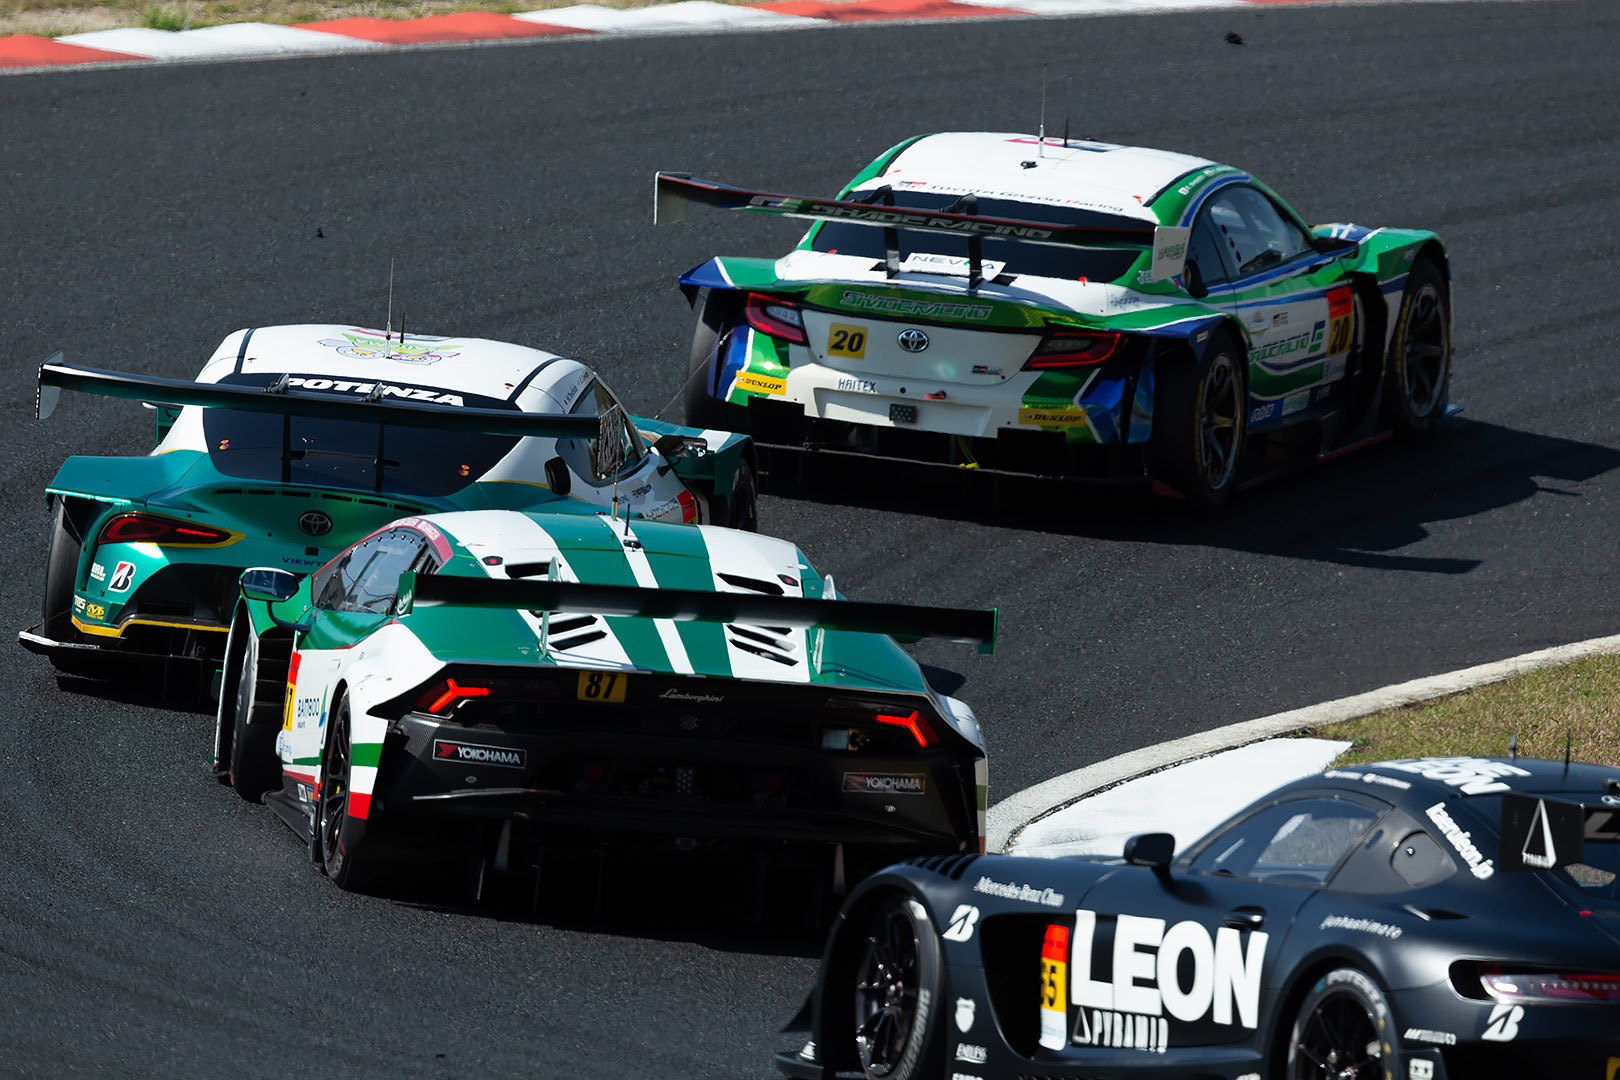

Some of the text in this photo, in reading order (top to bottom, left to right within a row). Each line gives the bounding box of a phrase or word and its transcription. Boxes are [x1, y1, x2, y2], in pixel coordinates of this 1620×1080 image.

[810, 204, 1052, 239] SHADE RACING
[913, 255, 995, 270] NEVA
[831, 329, 865, 353] 20
[288, 377, 464, 407] POTENZA
[745, 377, 782, 391] DUNLOP
[837, 378, 878, 393] HAITEX
[1033, 413, 1082, 423] DUNLOP
[585, 672, 618, 699] 87
[658, 688, 724, 703] Lamborghini
[457, 746, 521, 765] YOKOHAMA
[865, 776, 921, 790] YOKOHAMA
[1071, 909, 1269, 1029] LEON
[1092, 1009, 1169, 1050] PYRAMID
